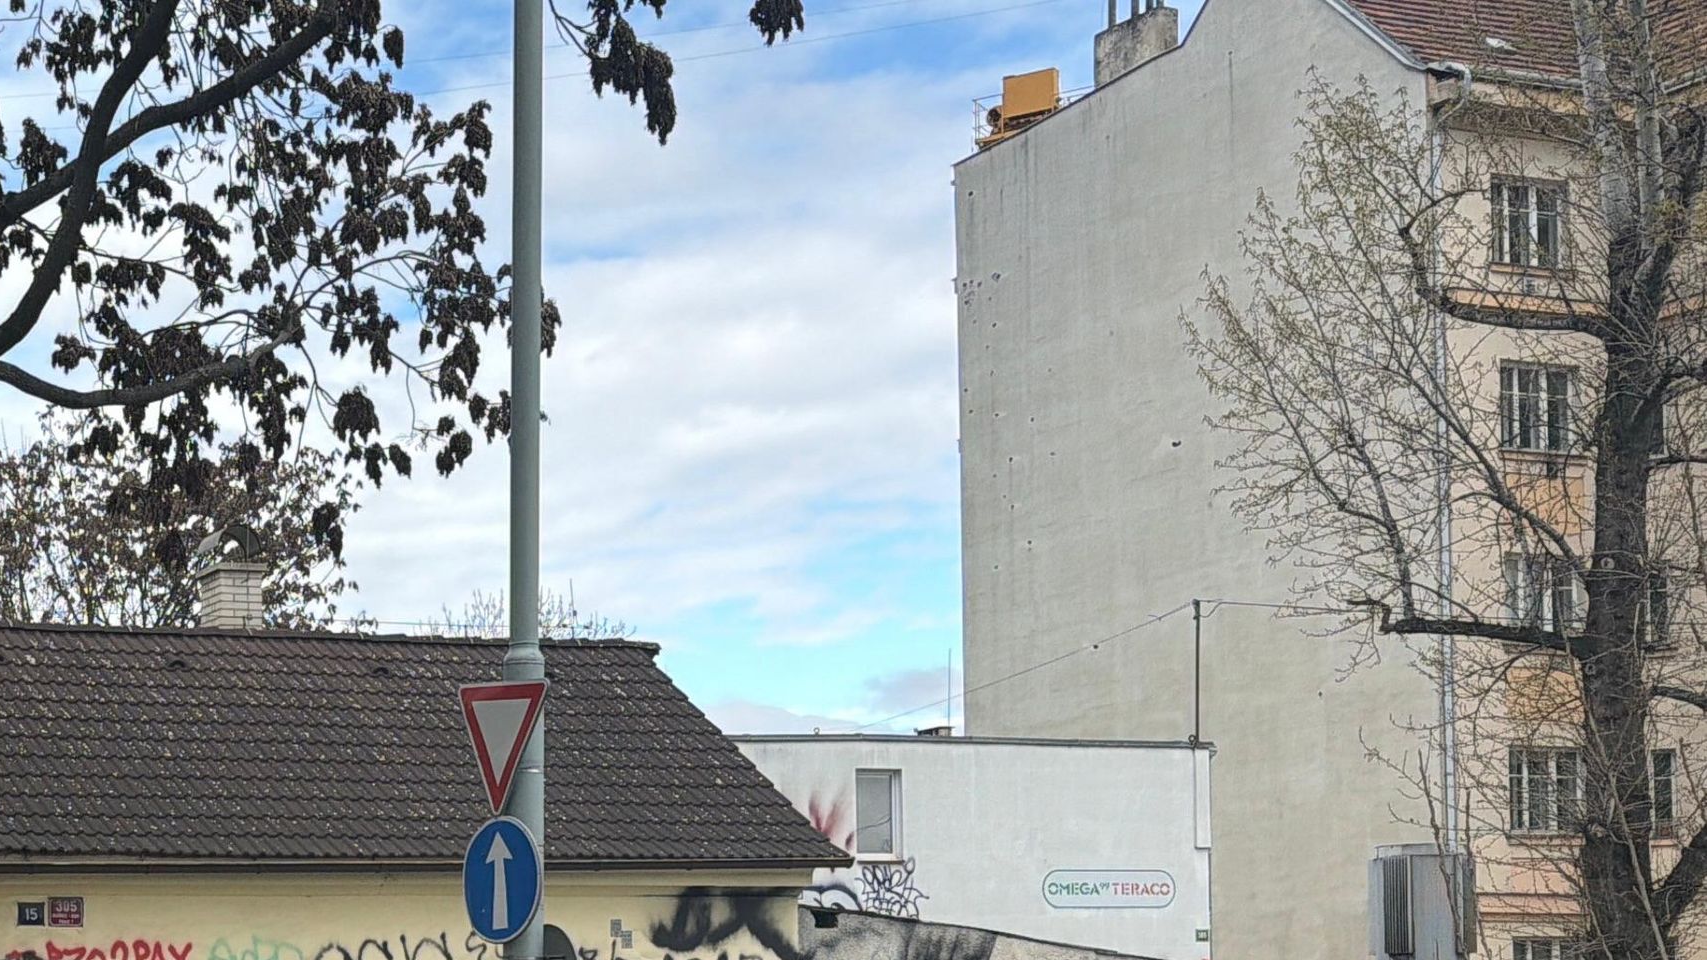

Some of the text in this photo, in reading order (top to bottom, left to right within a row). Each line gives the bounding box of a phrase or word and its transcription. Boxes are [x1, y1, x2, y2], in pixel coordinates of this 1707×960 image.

[1112, 882, 1171, 896] TERACO
[55, 901, 78, 912] 305
[25, 908, 38, 921] 15
